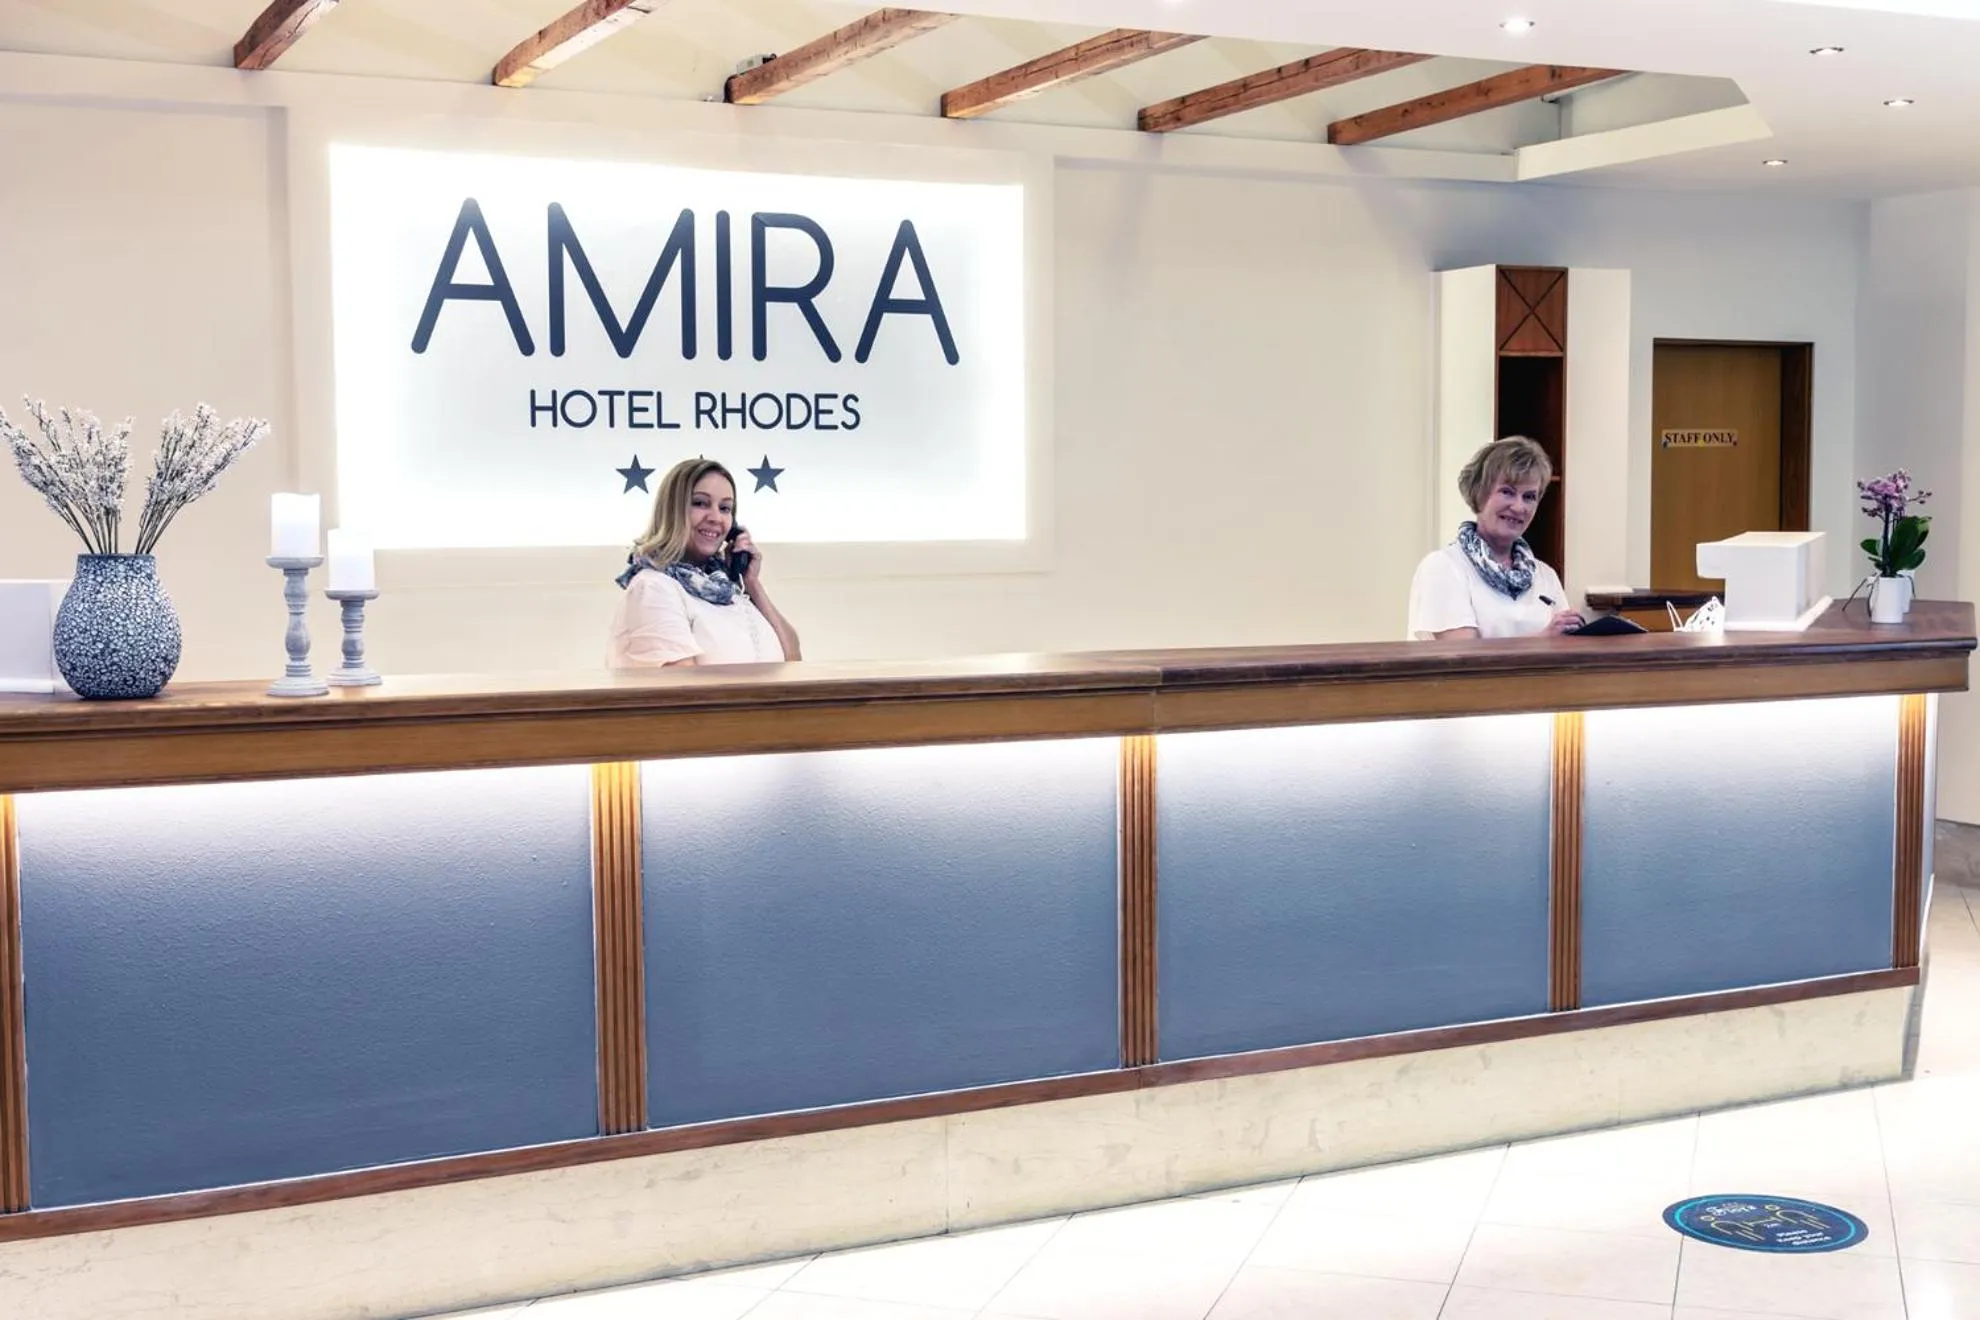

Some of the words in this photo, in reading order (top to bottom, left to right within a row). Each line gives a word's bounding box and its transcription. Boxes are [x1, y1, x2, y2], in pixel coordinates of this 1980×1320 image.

[411, 197, 960, 366] AMIRA
[530, 389, 681, 429] HOTEL
[694, 391, 861, 431] RHODES
[1664, 432, 1700, 444] STAFF
[1703, 432, 1735, 444] ONLY
